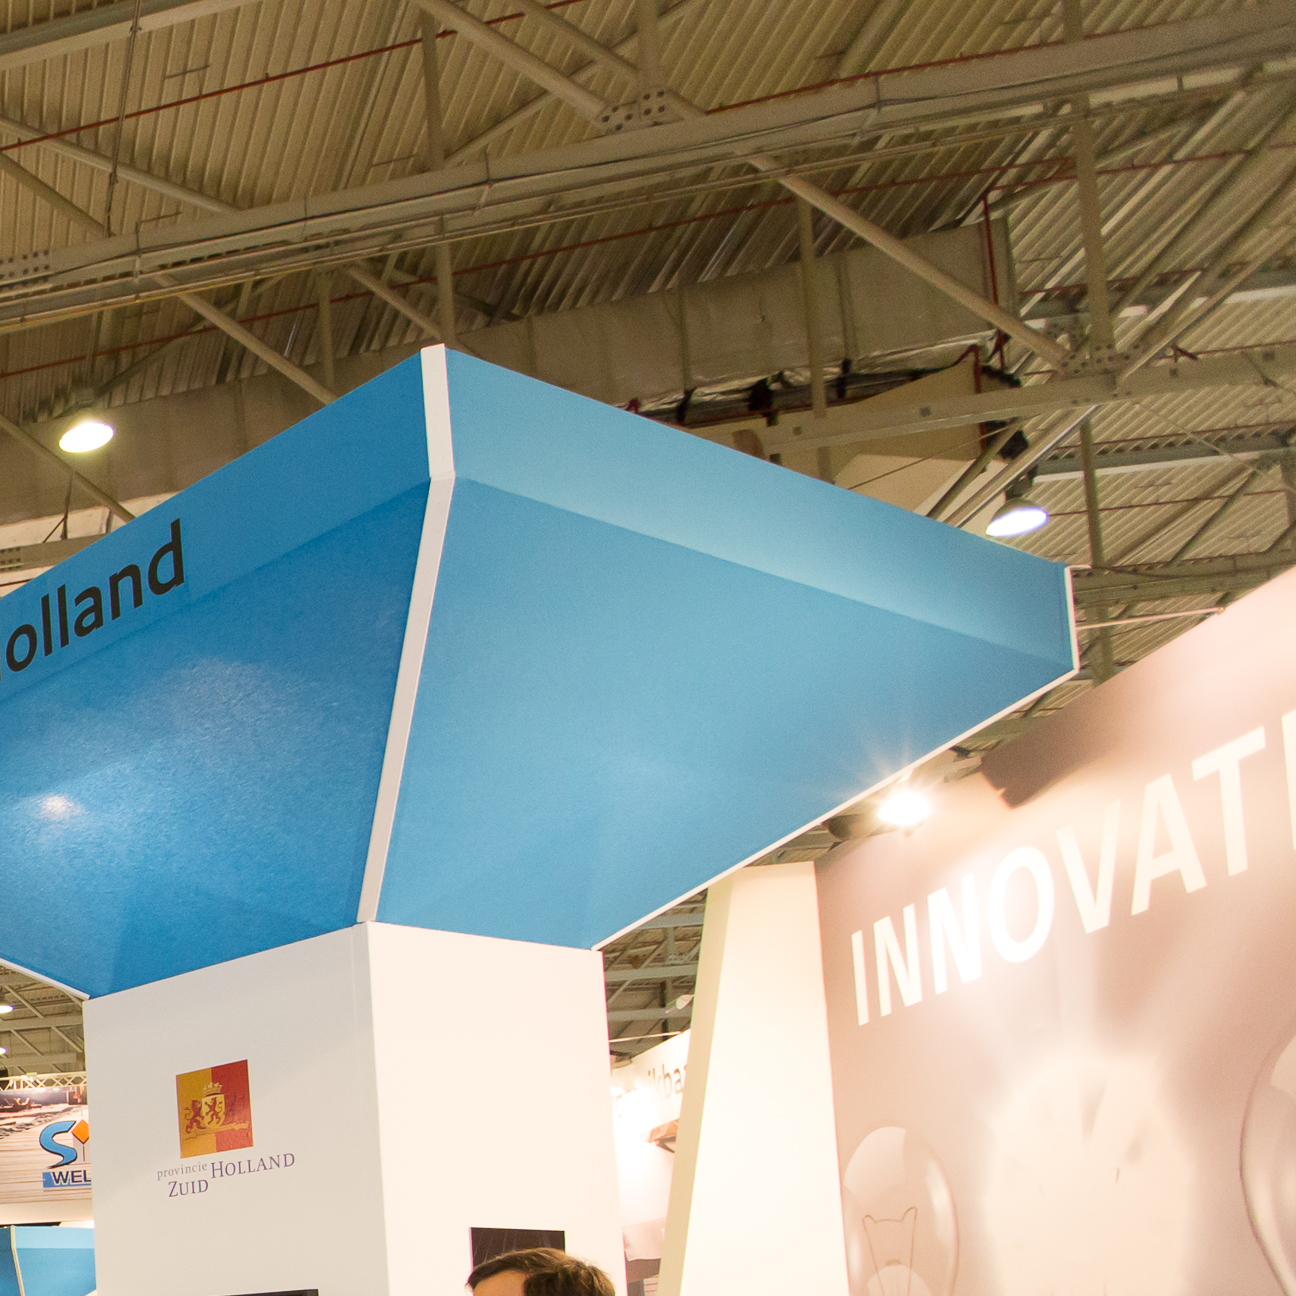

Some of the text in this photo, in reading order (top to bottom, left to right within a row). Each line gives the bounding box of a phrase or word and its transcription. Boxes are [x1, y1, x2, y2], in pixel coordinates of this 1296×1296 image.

[52, 1169, 92, 1185] WEL
[157, 1161, 208, 1181] provincie
[168, 1178, 209, 1198] ZUID
